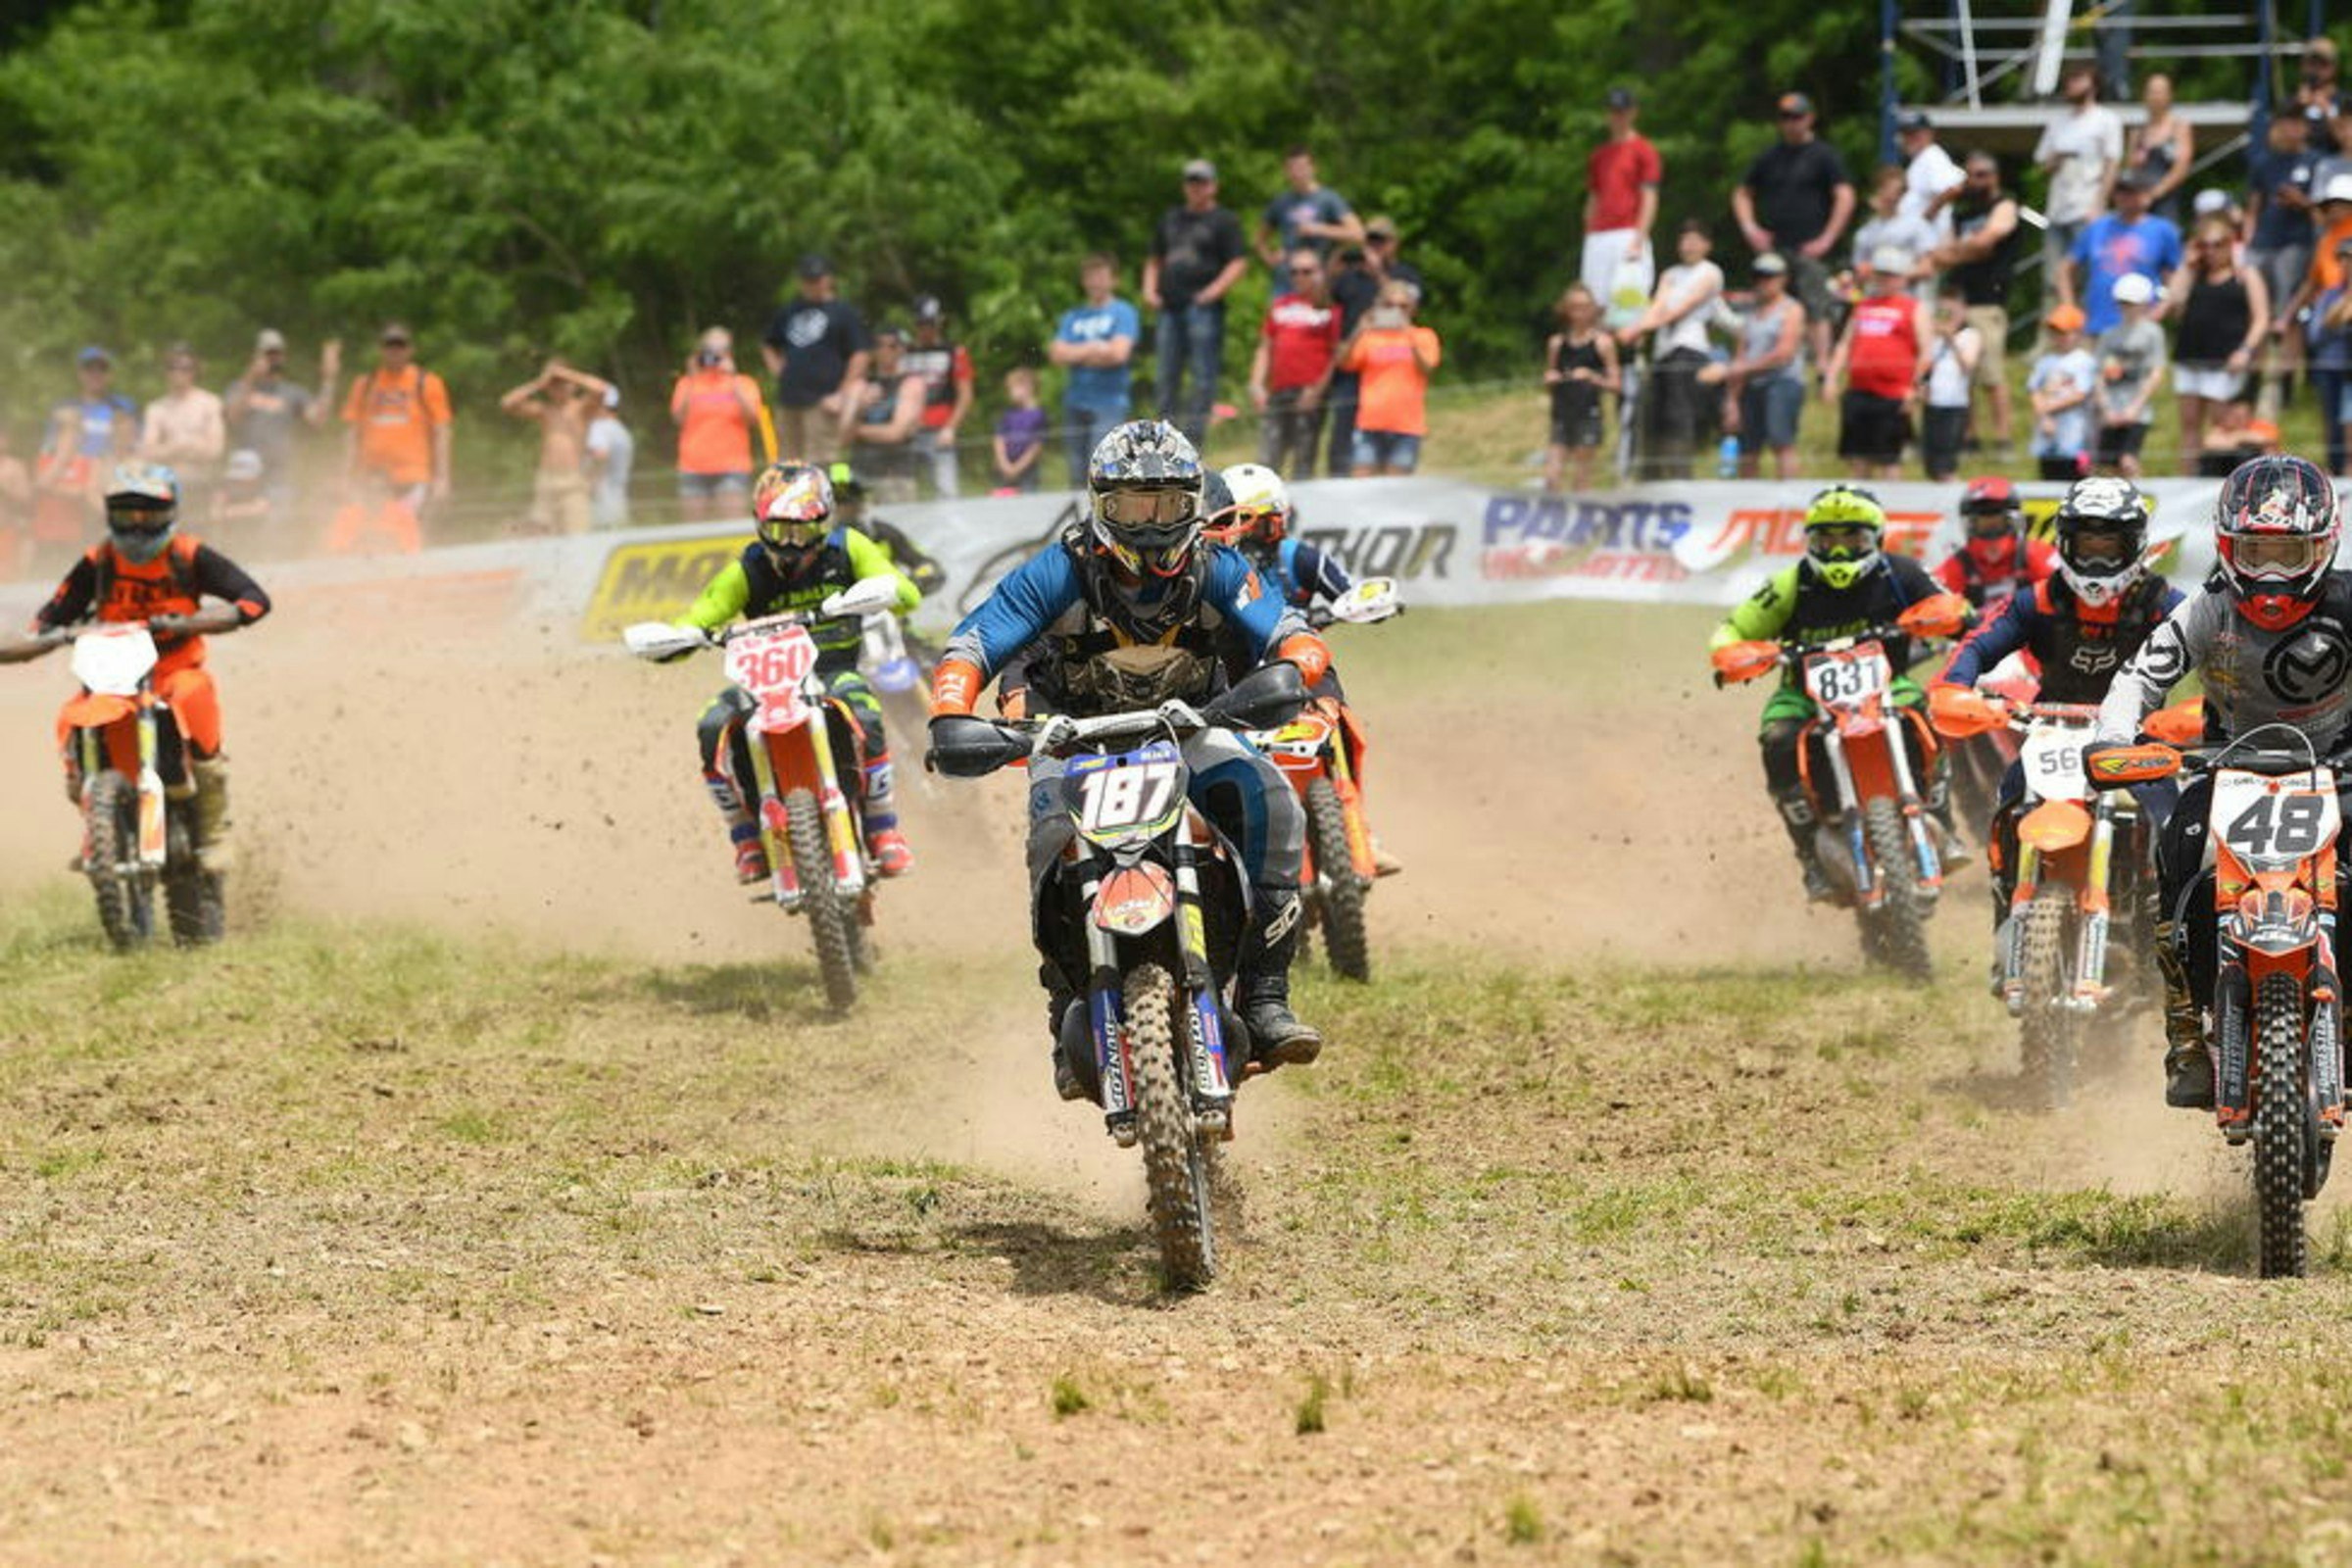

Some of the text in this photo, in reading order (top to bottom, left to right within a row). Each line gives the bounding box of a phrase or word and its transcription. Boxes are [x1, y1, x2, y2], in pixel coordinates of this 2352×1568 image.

[1482, 496, 1692, 548] PARTS
[1301, 523, 1457, 579] THOR
[736, 644, 811, 689] 360
[1819, 657, 1881, 703] 831
[2039, 747, 2079, 775] 56
[1079, 762, 1177, 833] 187
[2226, 795, 2324, 855] 48
[1104, 1020, 1125, 1107] DUNLOP
[1187, 1004, 1212, 1090] DUNLOP
